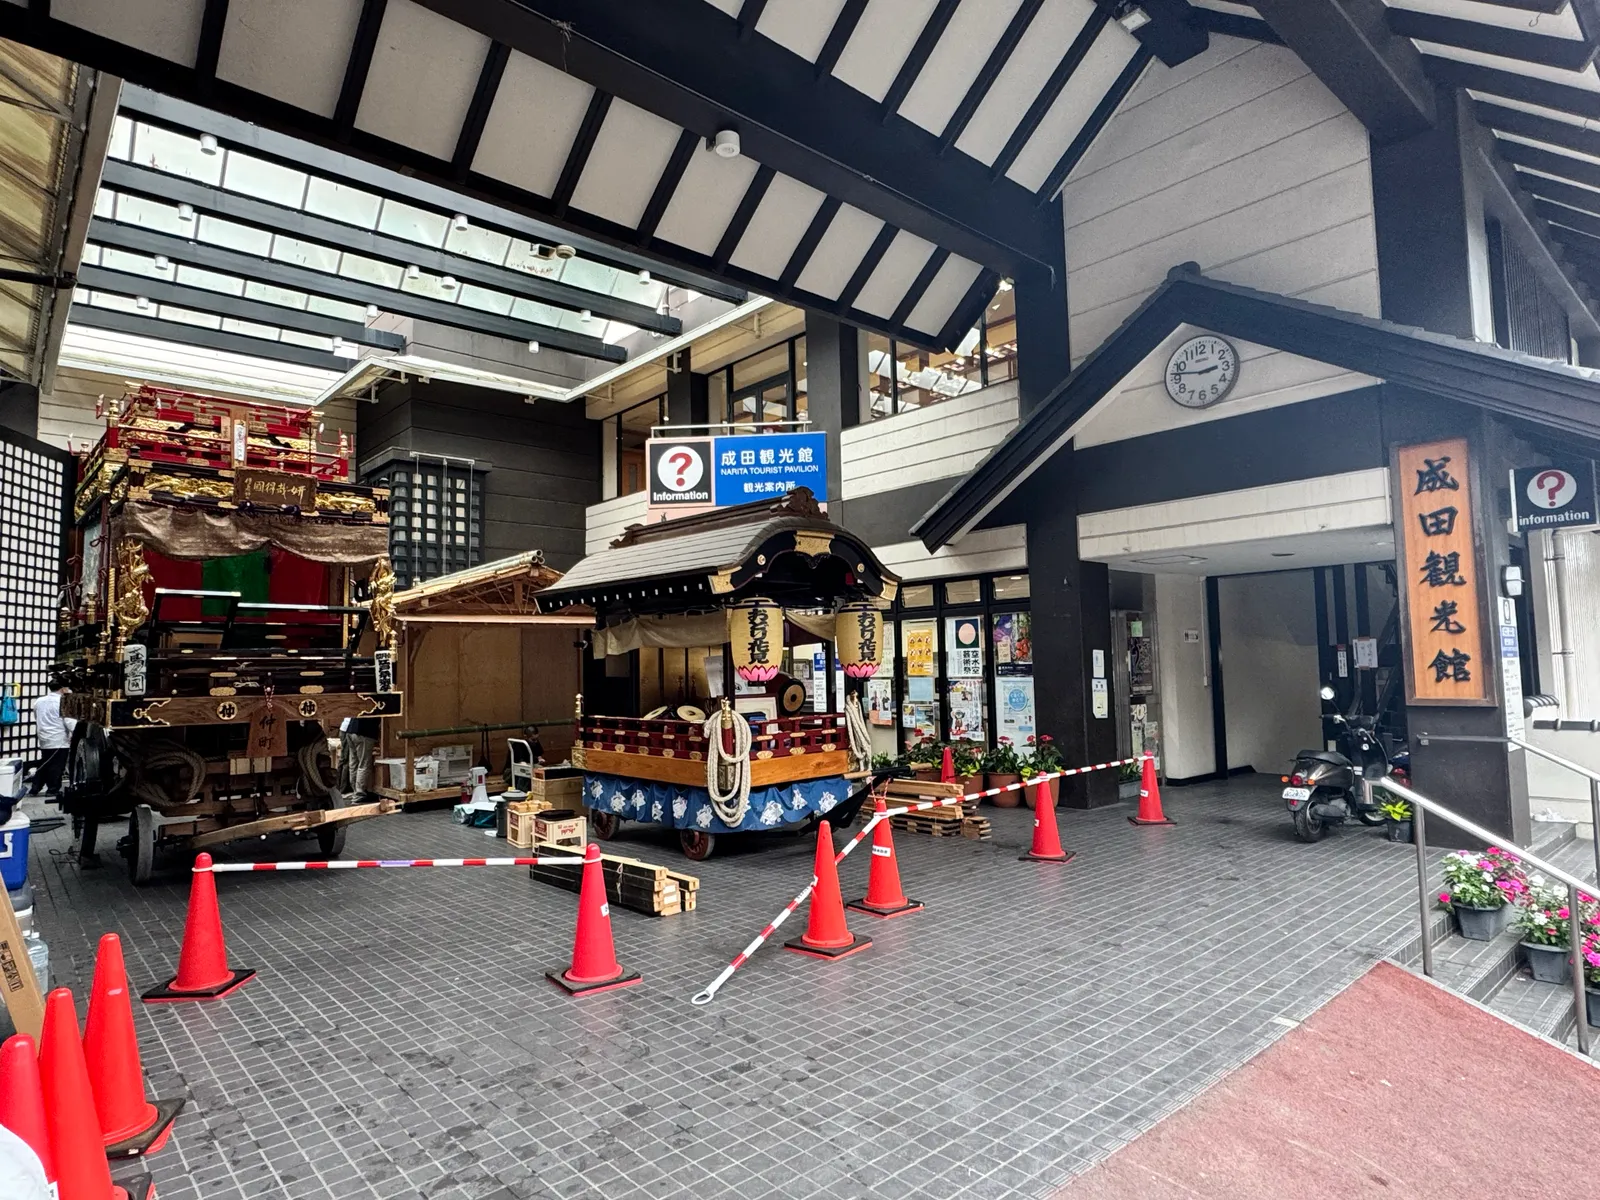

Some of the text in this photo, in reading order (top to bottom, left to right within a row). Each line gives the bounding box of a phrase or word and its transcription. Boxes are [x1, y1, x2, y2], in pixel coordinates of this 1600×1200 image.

[1184, 349, 1193, 361] 11
[1195, 344, 1206, 356] 12
[1210, 343, 1214, 355] 1
[1218, 349, 1226, 361] 2
[1174, 360, 1186, 372] 10
[1221, 360, 1230, 371] 3
[1173, 373, 1181, 384] 9
[1219, 373, 1227, 383] 4
[1178, 383, 1186, 393] 8
[1211, 384, 1219, 394] 5
[1187, 390, 1196, 400] 7
[1198, 390, 1207, 400] 6
[721, 447, 813, 466] 成田観光館
[720, 464, 819, 476] NARITA TOURIST PAVILION
[743, 480, 796, 493] 観光案内所
[653, 490, 709, 502] Information
[1519, 509, 1590, 526] information
[1413, 456, 1472, 684] 成田観光館
[259, 713, 277, 750] 仲町
